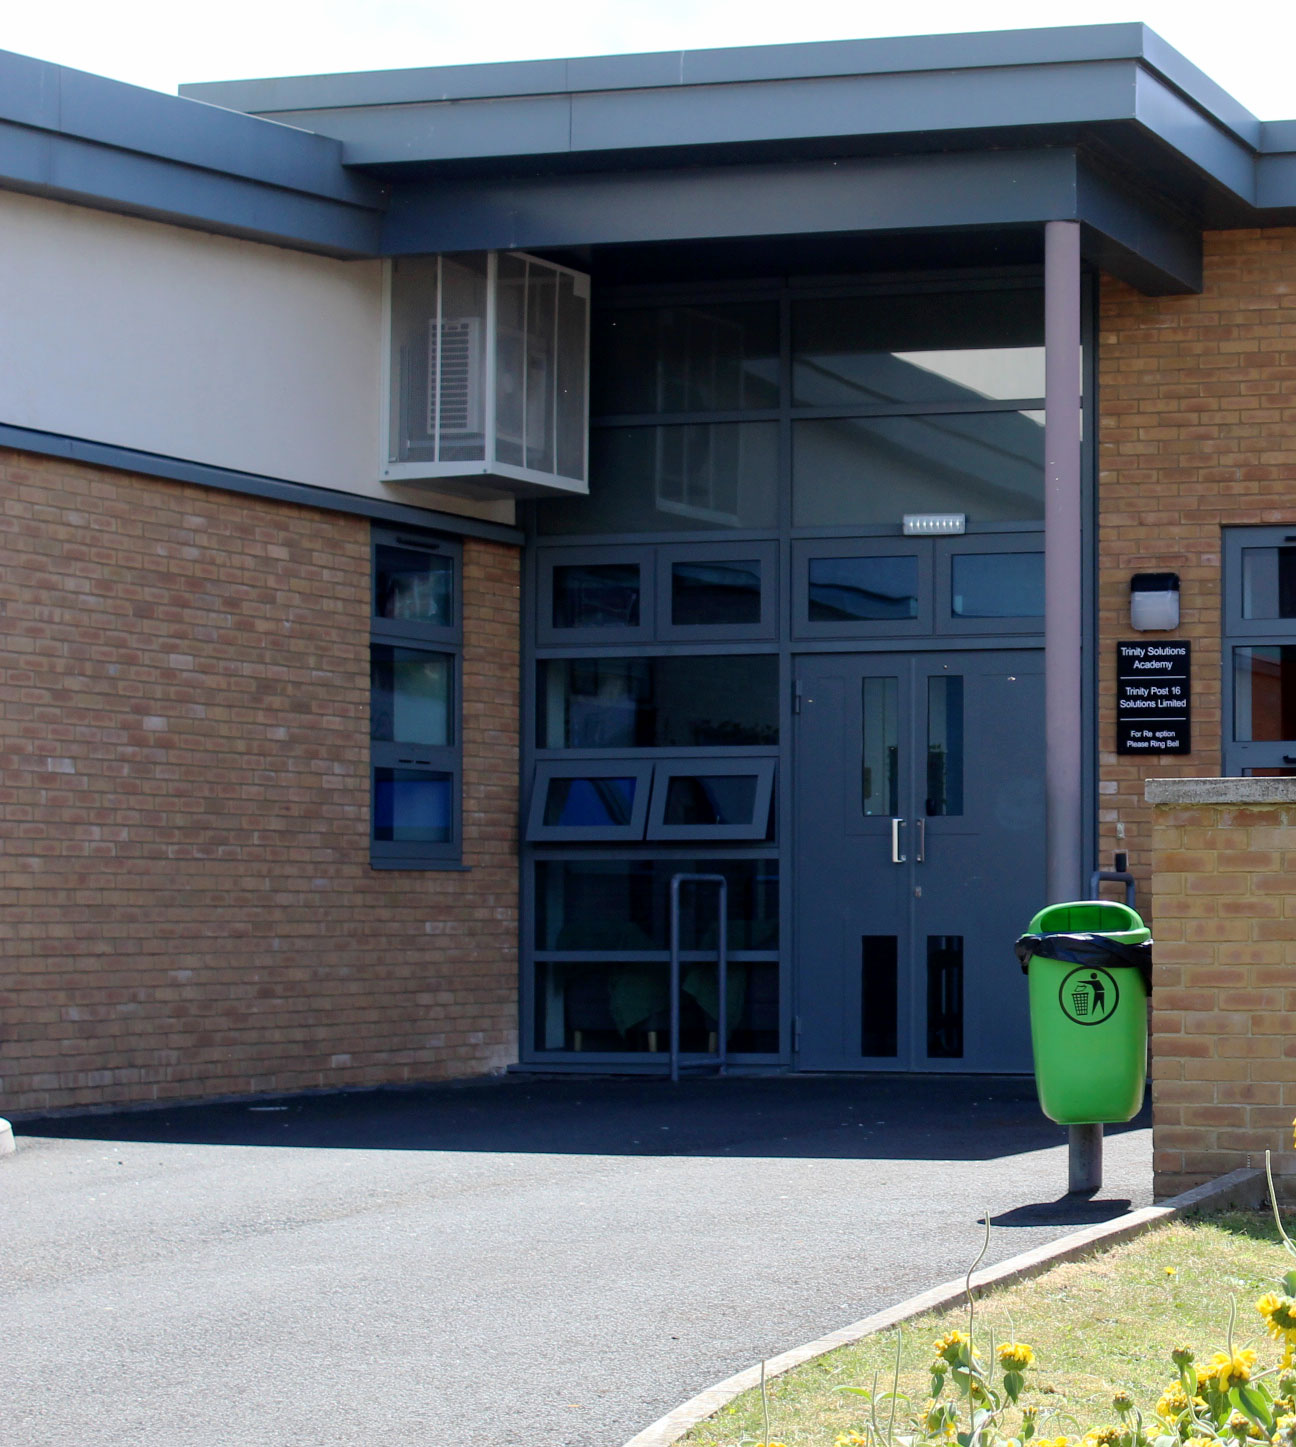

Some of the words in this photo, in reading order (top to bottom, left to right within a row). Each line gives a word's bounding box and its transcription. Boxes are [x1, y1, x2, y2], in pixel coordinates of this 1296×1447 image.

[1121, 647, 1145, 657] Trinity
[1148, 647, 1185, 655] Solutions
[1133, 661, 1173, 670] Academy
[1126, 688, 1149, 696] Trinity
[1151, 687, 1168, 695] Post
[1120, 700, 1156, 708] Solutions
[1158, 699, 1186, 707] Limited
